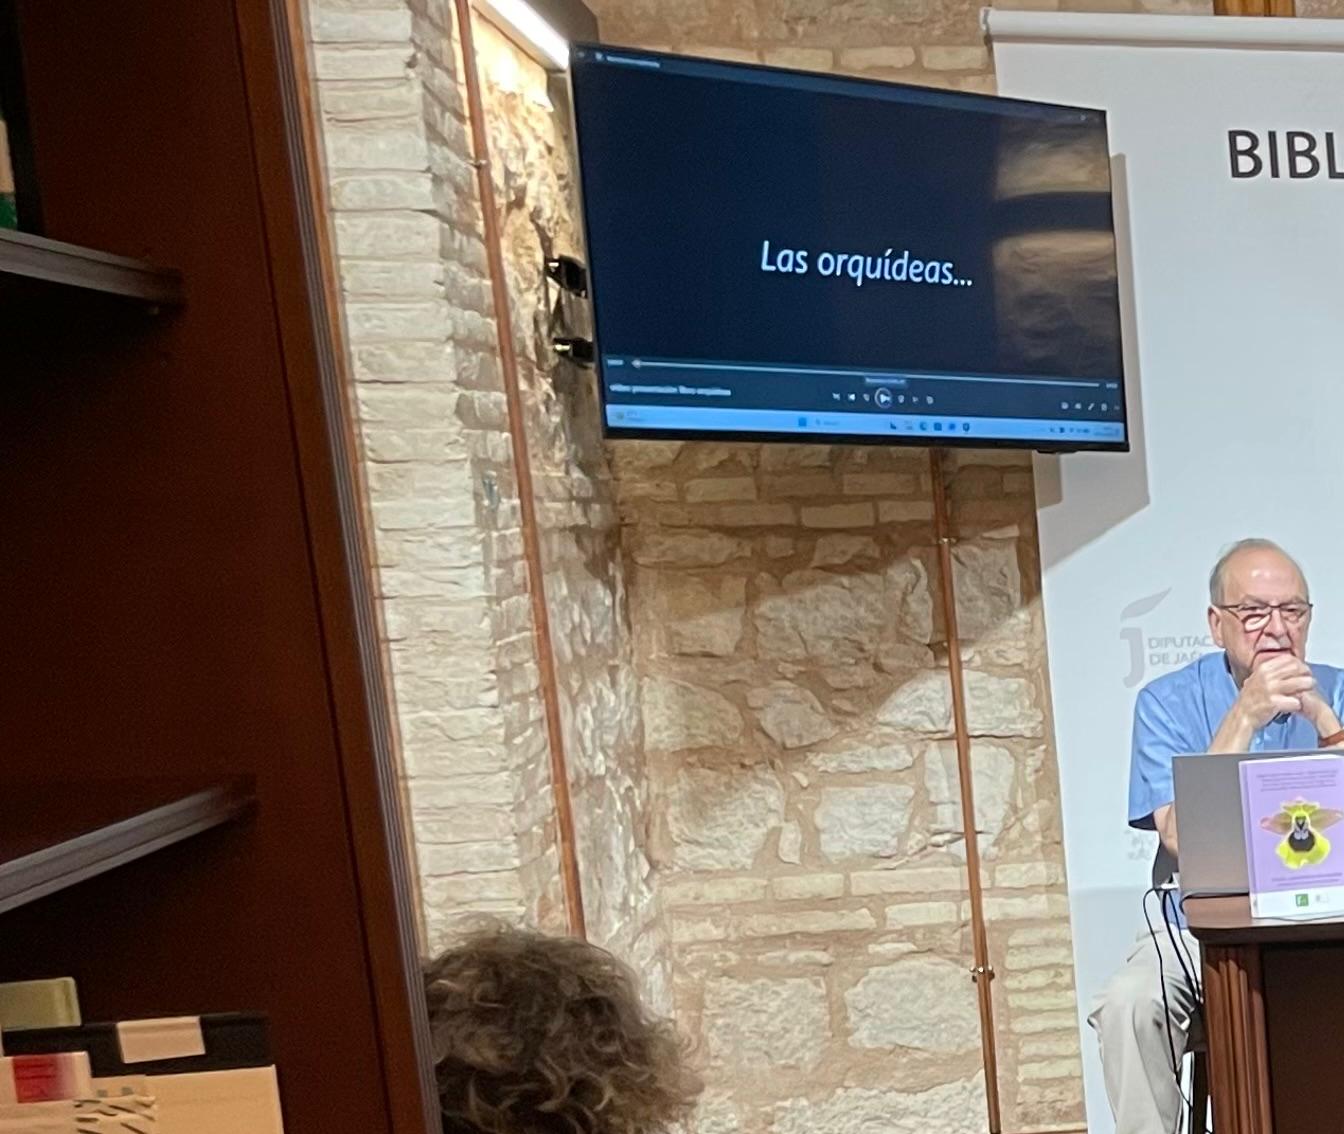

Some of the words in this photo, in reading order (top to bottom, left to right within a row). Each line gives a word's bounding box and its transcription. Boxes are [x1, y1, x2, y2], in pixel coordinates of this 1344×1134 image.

[760, 239, 809, 275] Las
[816, 248, 974, 288] orquídeas...
[1149, 653, 1168, 666] DE
